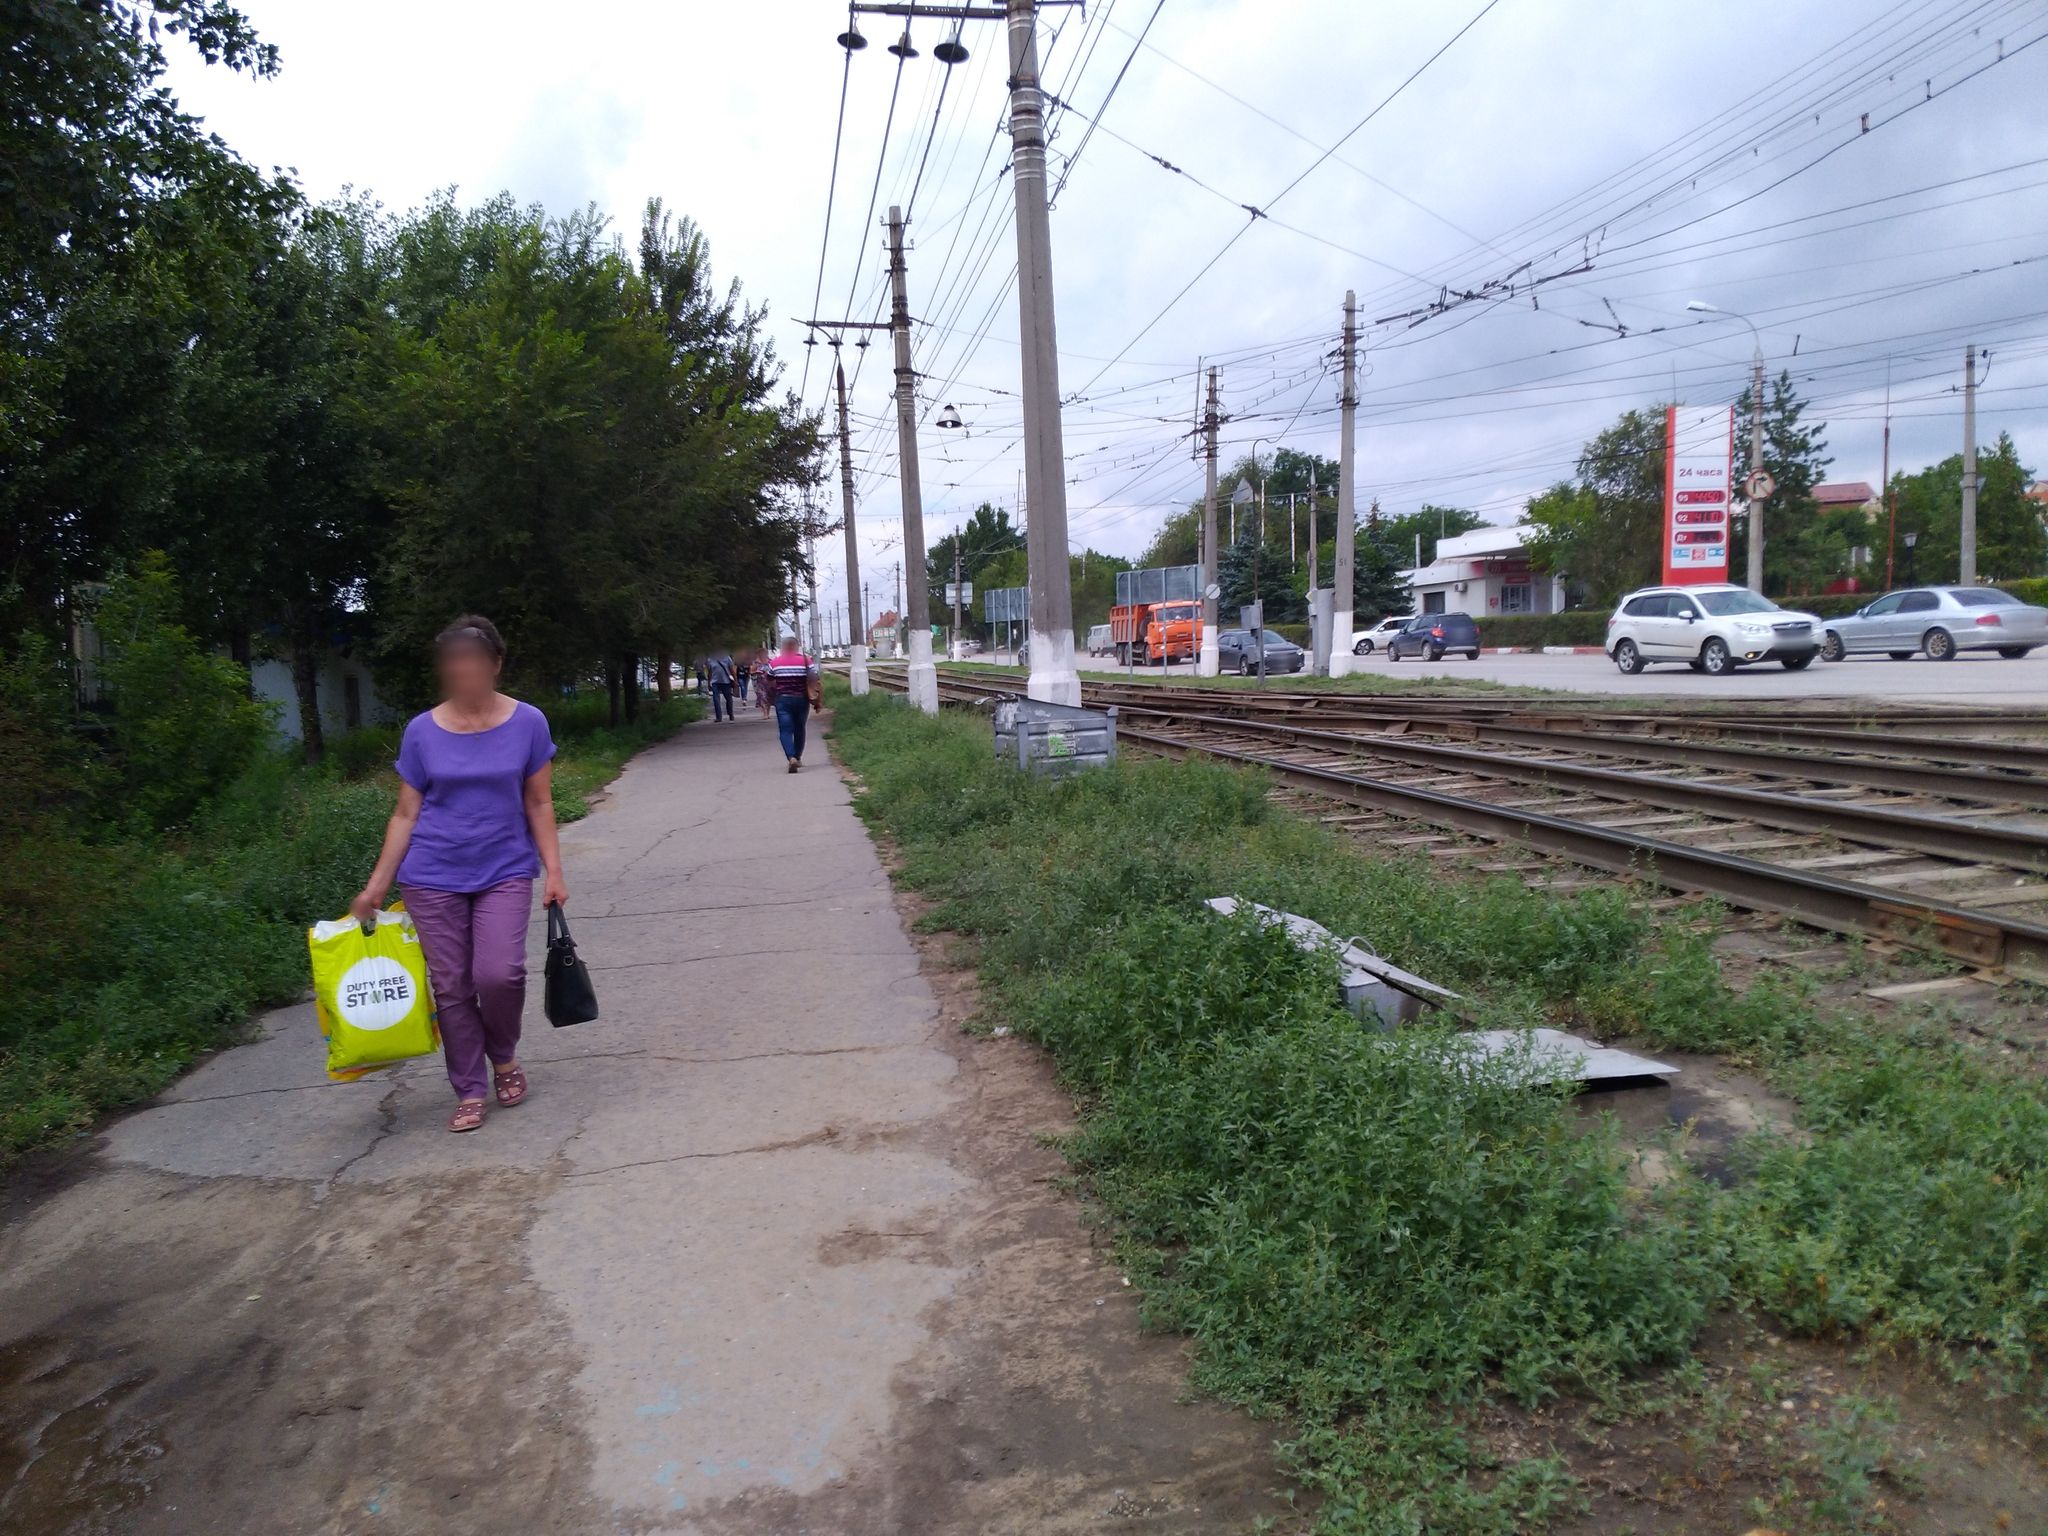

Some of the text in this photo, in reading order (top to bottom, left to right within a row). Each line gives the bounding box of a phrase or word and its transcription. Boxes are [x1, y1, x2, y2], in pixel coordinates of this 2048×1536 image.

[1679, 468, 1723, 477] 24 часа
[347, 975, 406, 994] DUTY FREE
